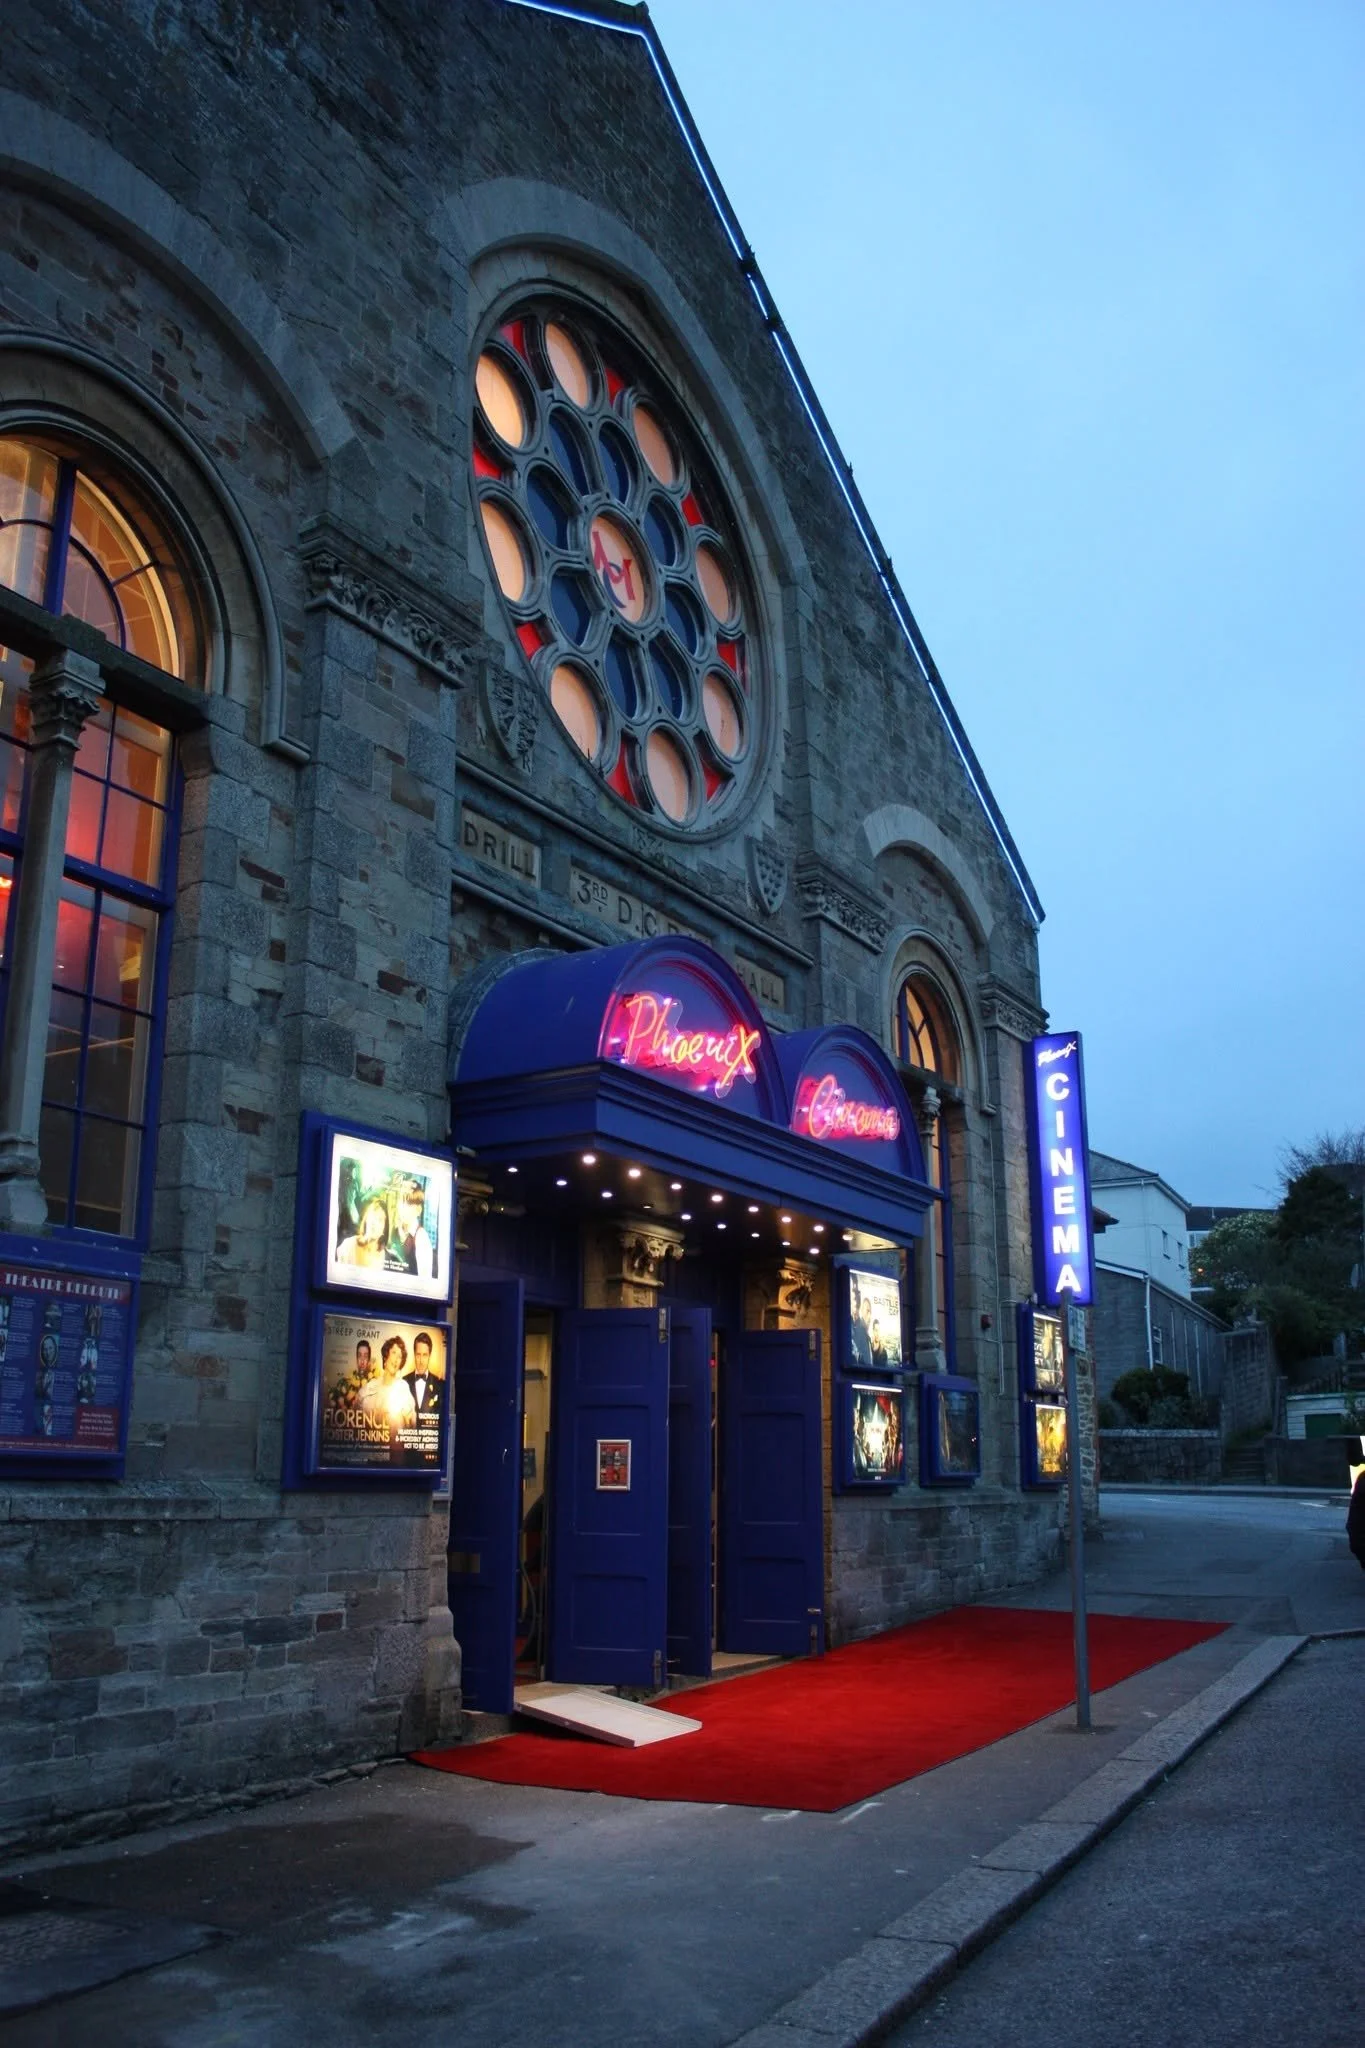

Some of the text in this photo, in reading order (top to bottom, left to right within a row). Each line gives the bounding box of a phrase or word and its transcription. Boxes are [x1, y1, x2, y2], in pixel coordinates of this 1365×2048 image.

[464, 820, 537, 881] DRILL
[1045, 1072, 1082, 1293] CINEMA
[356, 1329, 380, 1340] GRANT
[323, 1407, 391, 1430] FLORENCE
[355, 1429, 391, 1443] JENKINS
